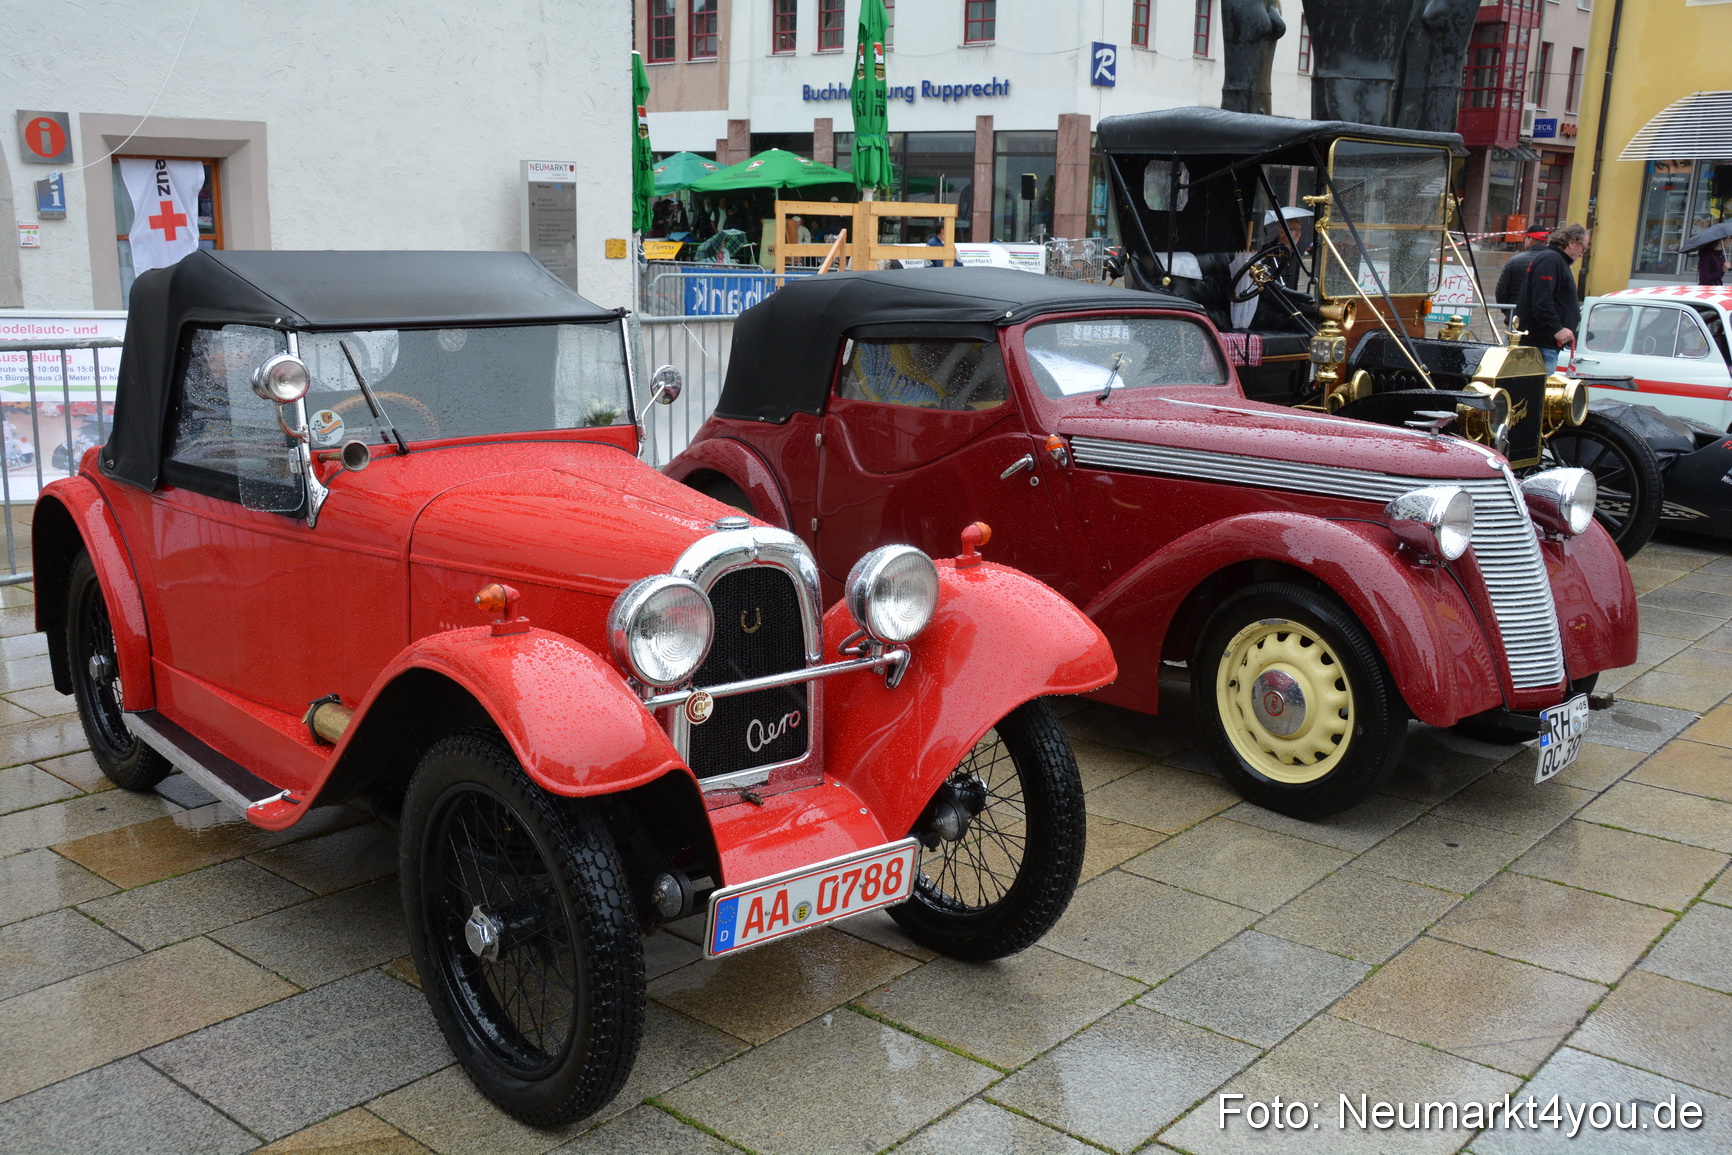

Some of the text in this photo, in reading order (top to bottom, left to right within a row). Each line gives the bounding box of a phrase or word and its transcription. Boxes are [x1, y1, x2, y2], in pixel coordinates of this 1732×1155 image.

[802, 83, 915, 103] Buchhung
[921, 77, 1010, 102] Rupprecht
[530, 164, 568, 172] NEUMARKT
[1008, 259, 1041, 267] NeuerMarkt
[0, 324, 98, 335] odellauto- und
[69, 373, 91, 381] Meter
[746, 710, 802, 753] Aero
[1549, 708, 1571, 744] RH
[1541, 743, 1562, 777] QC
[741, 857, 904, 939] AA 0788
[720, 930, 729, 942] D
